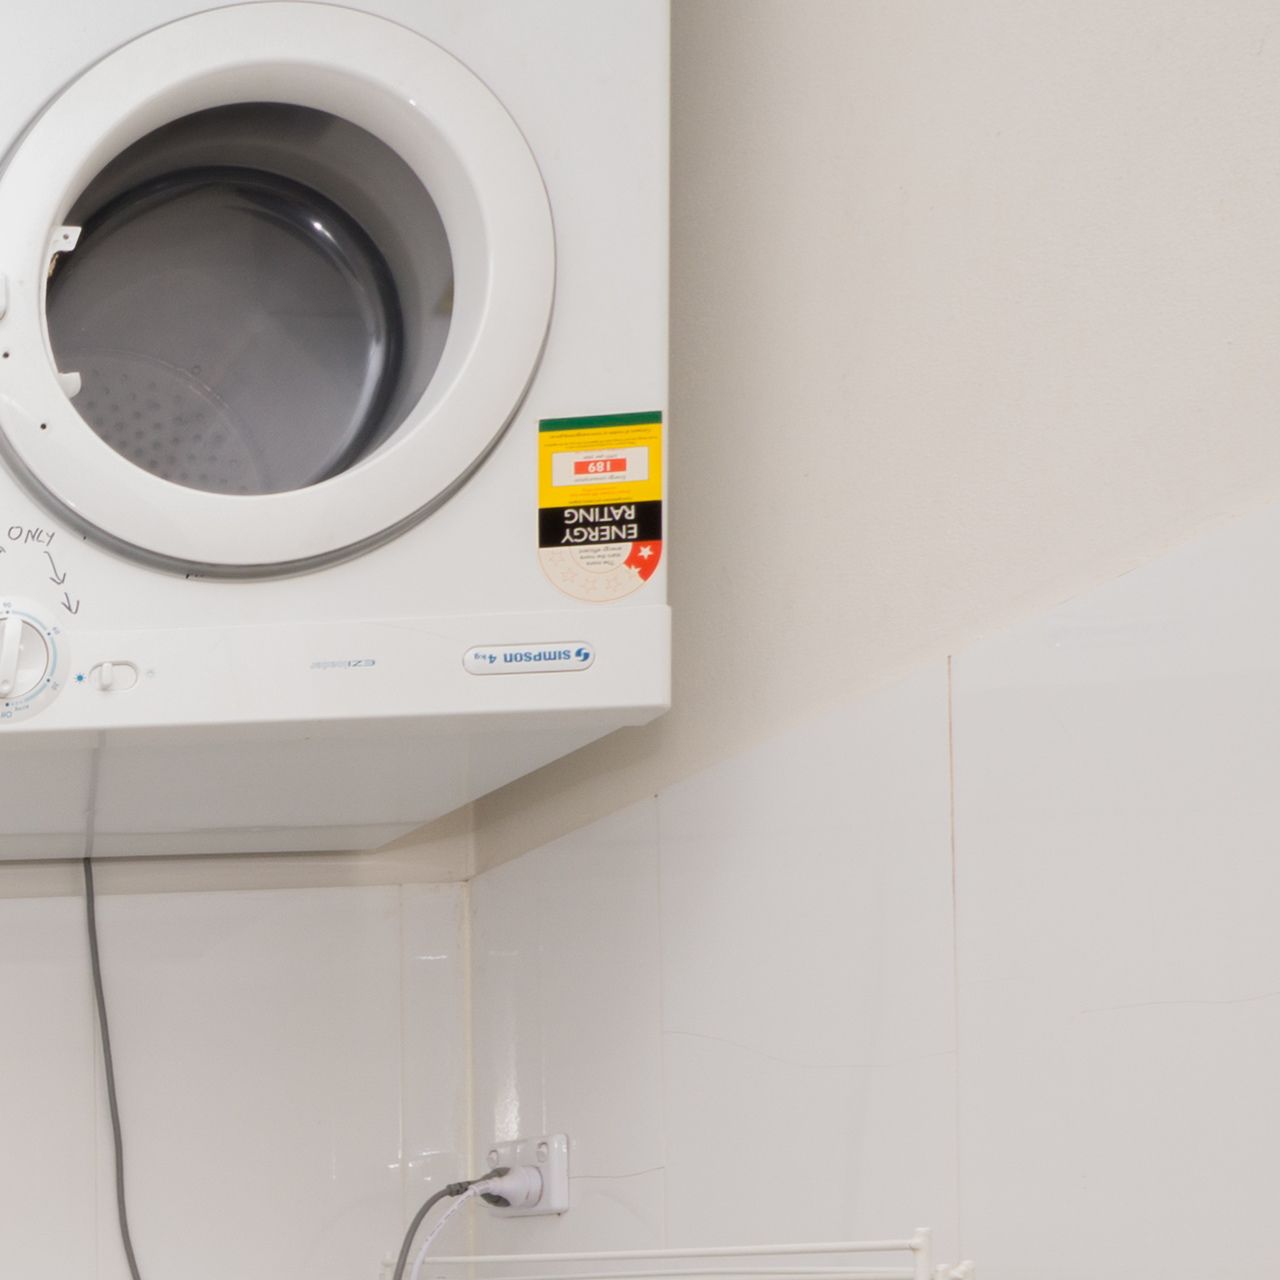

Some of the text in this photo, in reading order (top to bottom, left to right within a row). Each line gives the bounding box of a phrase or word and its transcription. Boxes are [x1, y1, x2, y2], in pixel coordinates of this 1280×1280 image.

[588, 460, 611, 473] 189
[564, 505, 635, 523] RATING
[7, 526, 56, 546] ONLY
[560, 523, 638, 543] ENERGY
[488, 653, 497, 664] 4
[503, 649, 571, 665] SIMPSON
